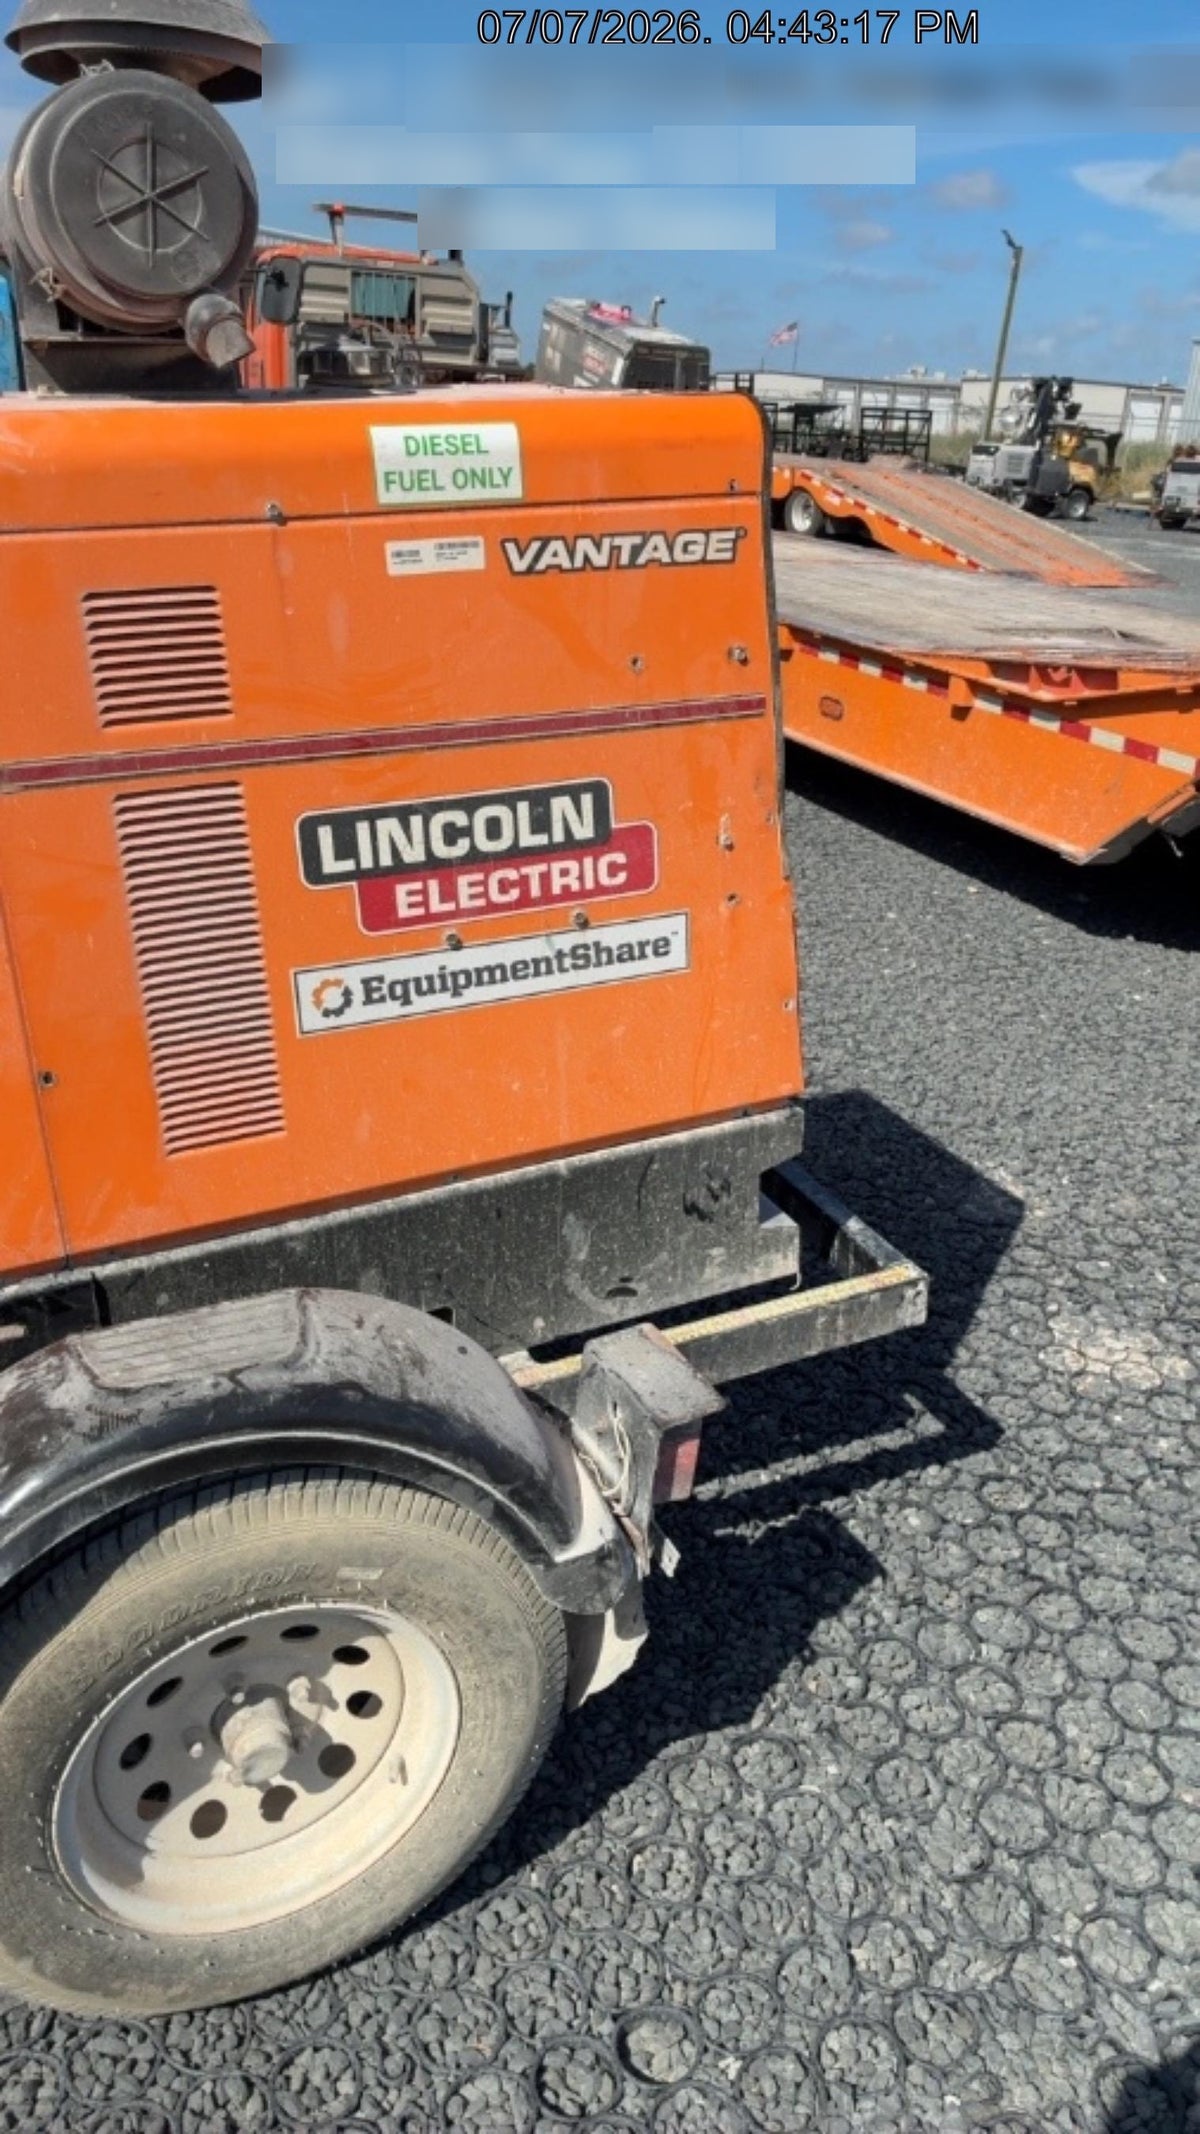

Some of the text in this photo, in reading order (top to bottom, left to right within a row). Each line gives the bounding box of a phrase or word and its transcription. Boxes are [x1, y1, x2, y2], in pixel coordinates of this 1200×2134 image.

[404, 433, 489, 456] DIESEL
[384, 467, 513, 492] FUEL ONLY
[502, 529, 741, 575] VANTAGE
[317, 792, 596, 875] LINCOLN
[395, 851, 628, 919] ELECTRIC
[360, 934, 673, 1007] EquipmentShare
